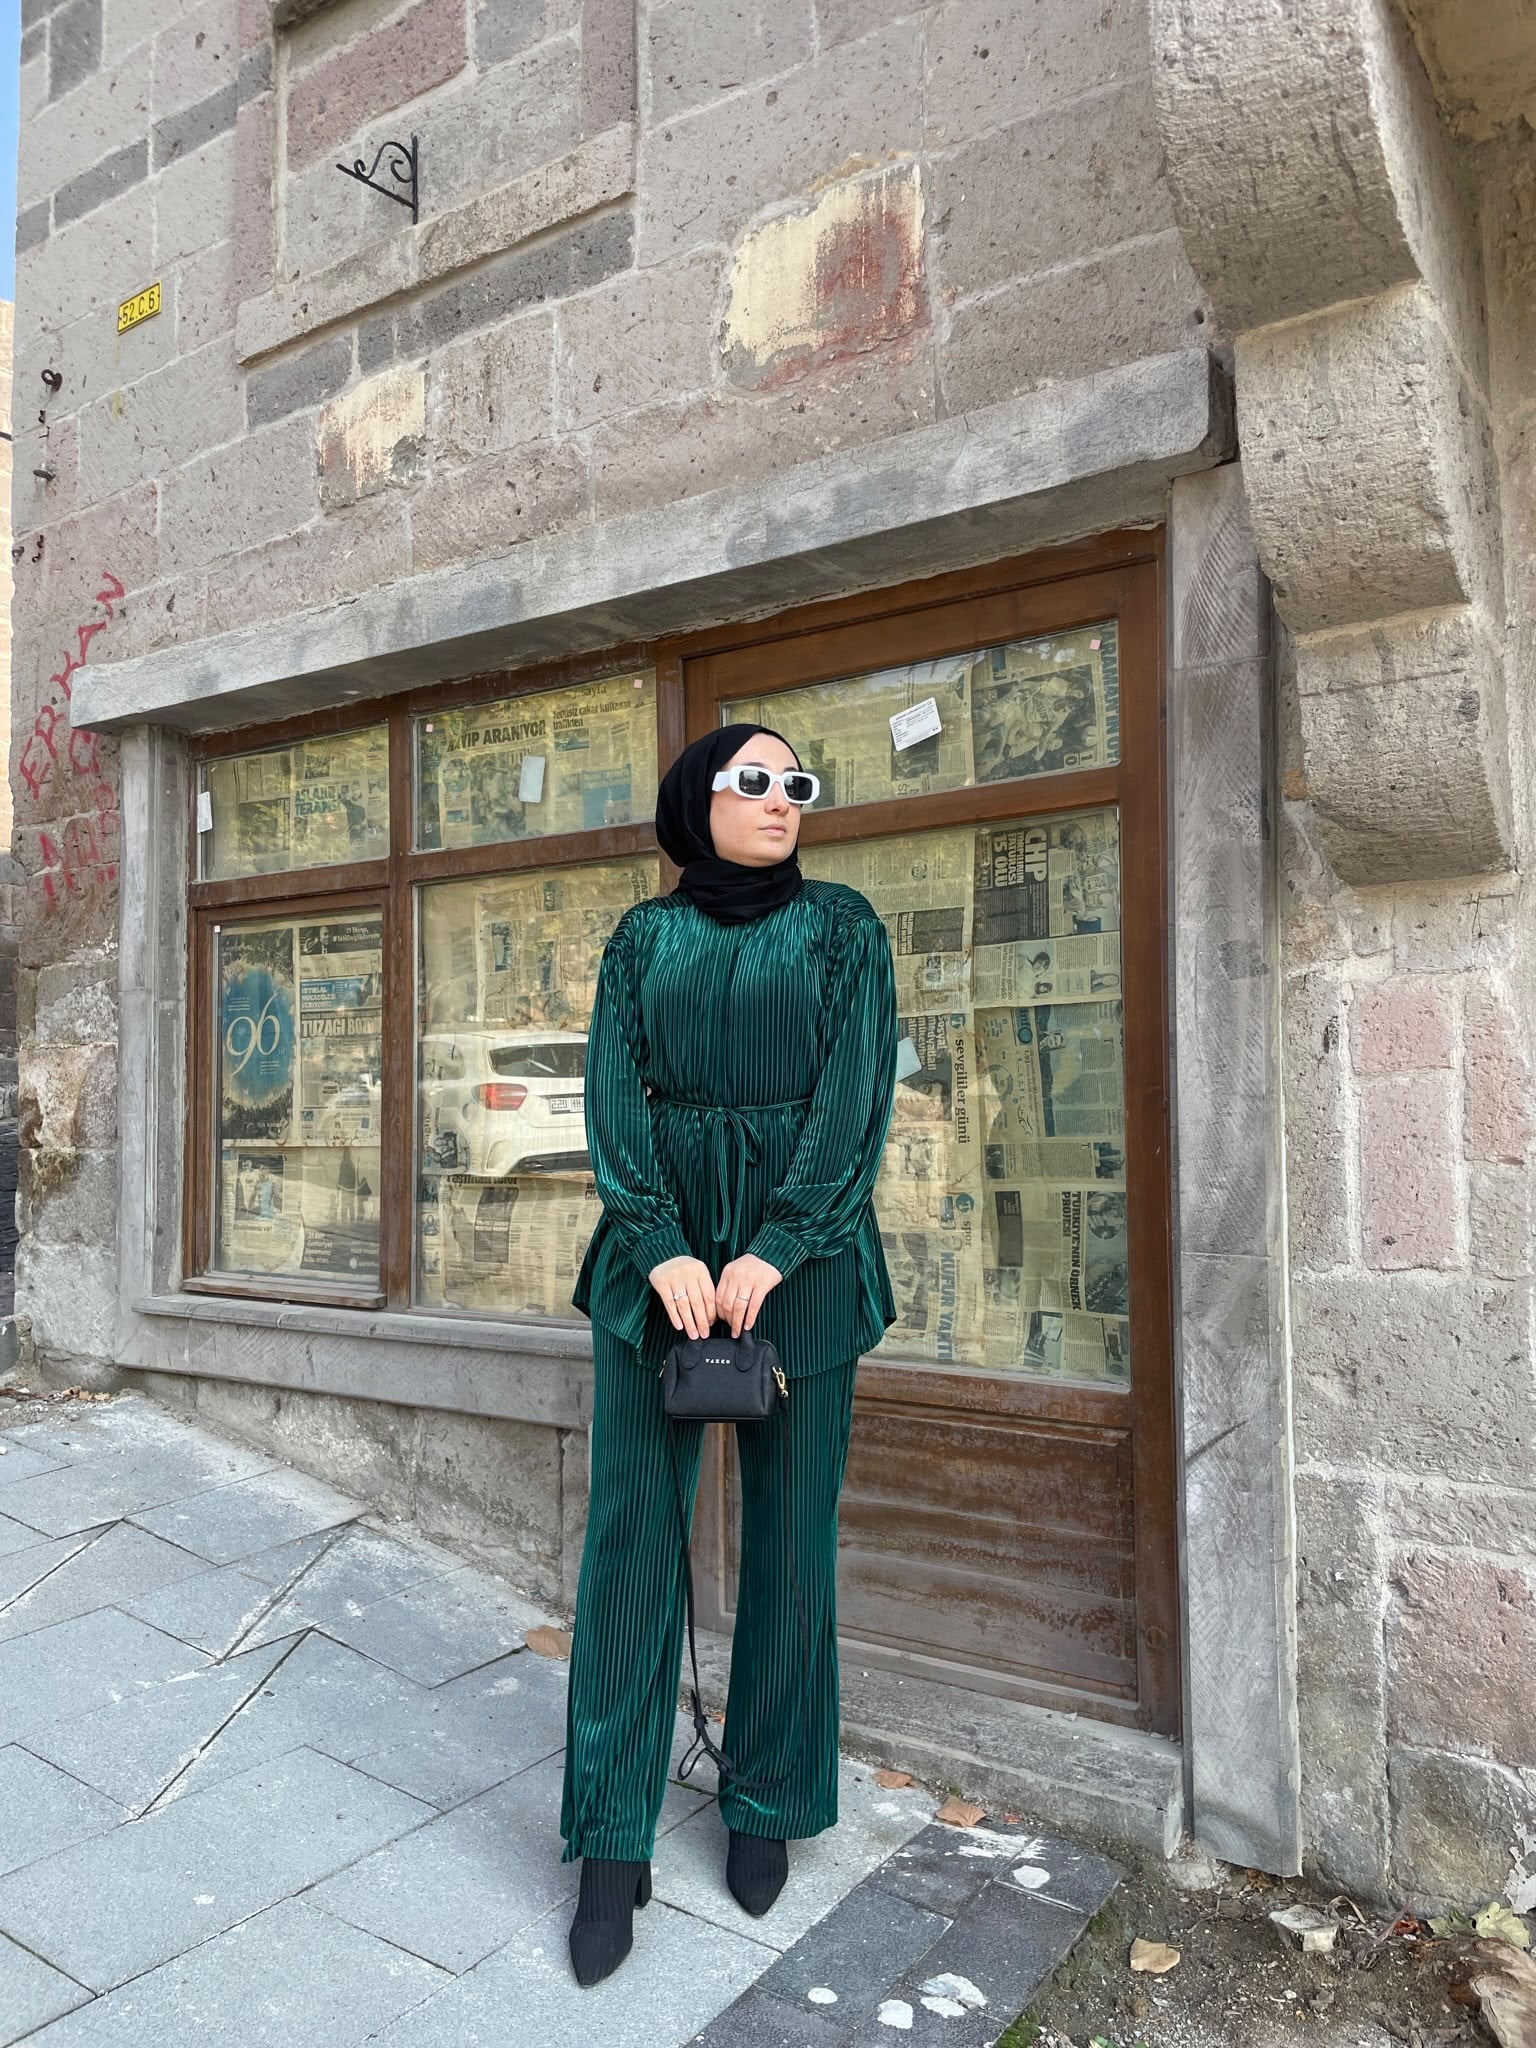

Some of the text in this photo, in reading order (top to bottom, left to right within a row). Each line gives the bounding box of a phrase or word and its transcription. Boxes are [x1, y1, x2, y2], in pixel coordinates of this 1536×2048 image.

[122, 290, 156, 325] 52.C.6
[1024, 828, 1048, 882] CHP
[226, 987, 280, 1076] 96
[926, 1016, 938, 1071] medyadan
[936, 1015, 948, 1049] Sosyal
[954, 1039, 968, 1104] sevgililer
[954, 1107, 970, 1144] günü
